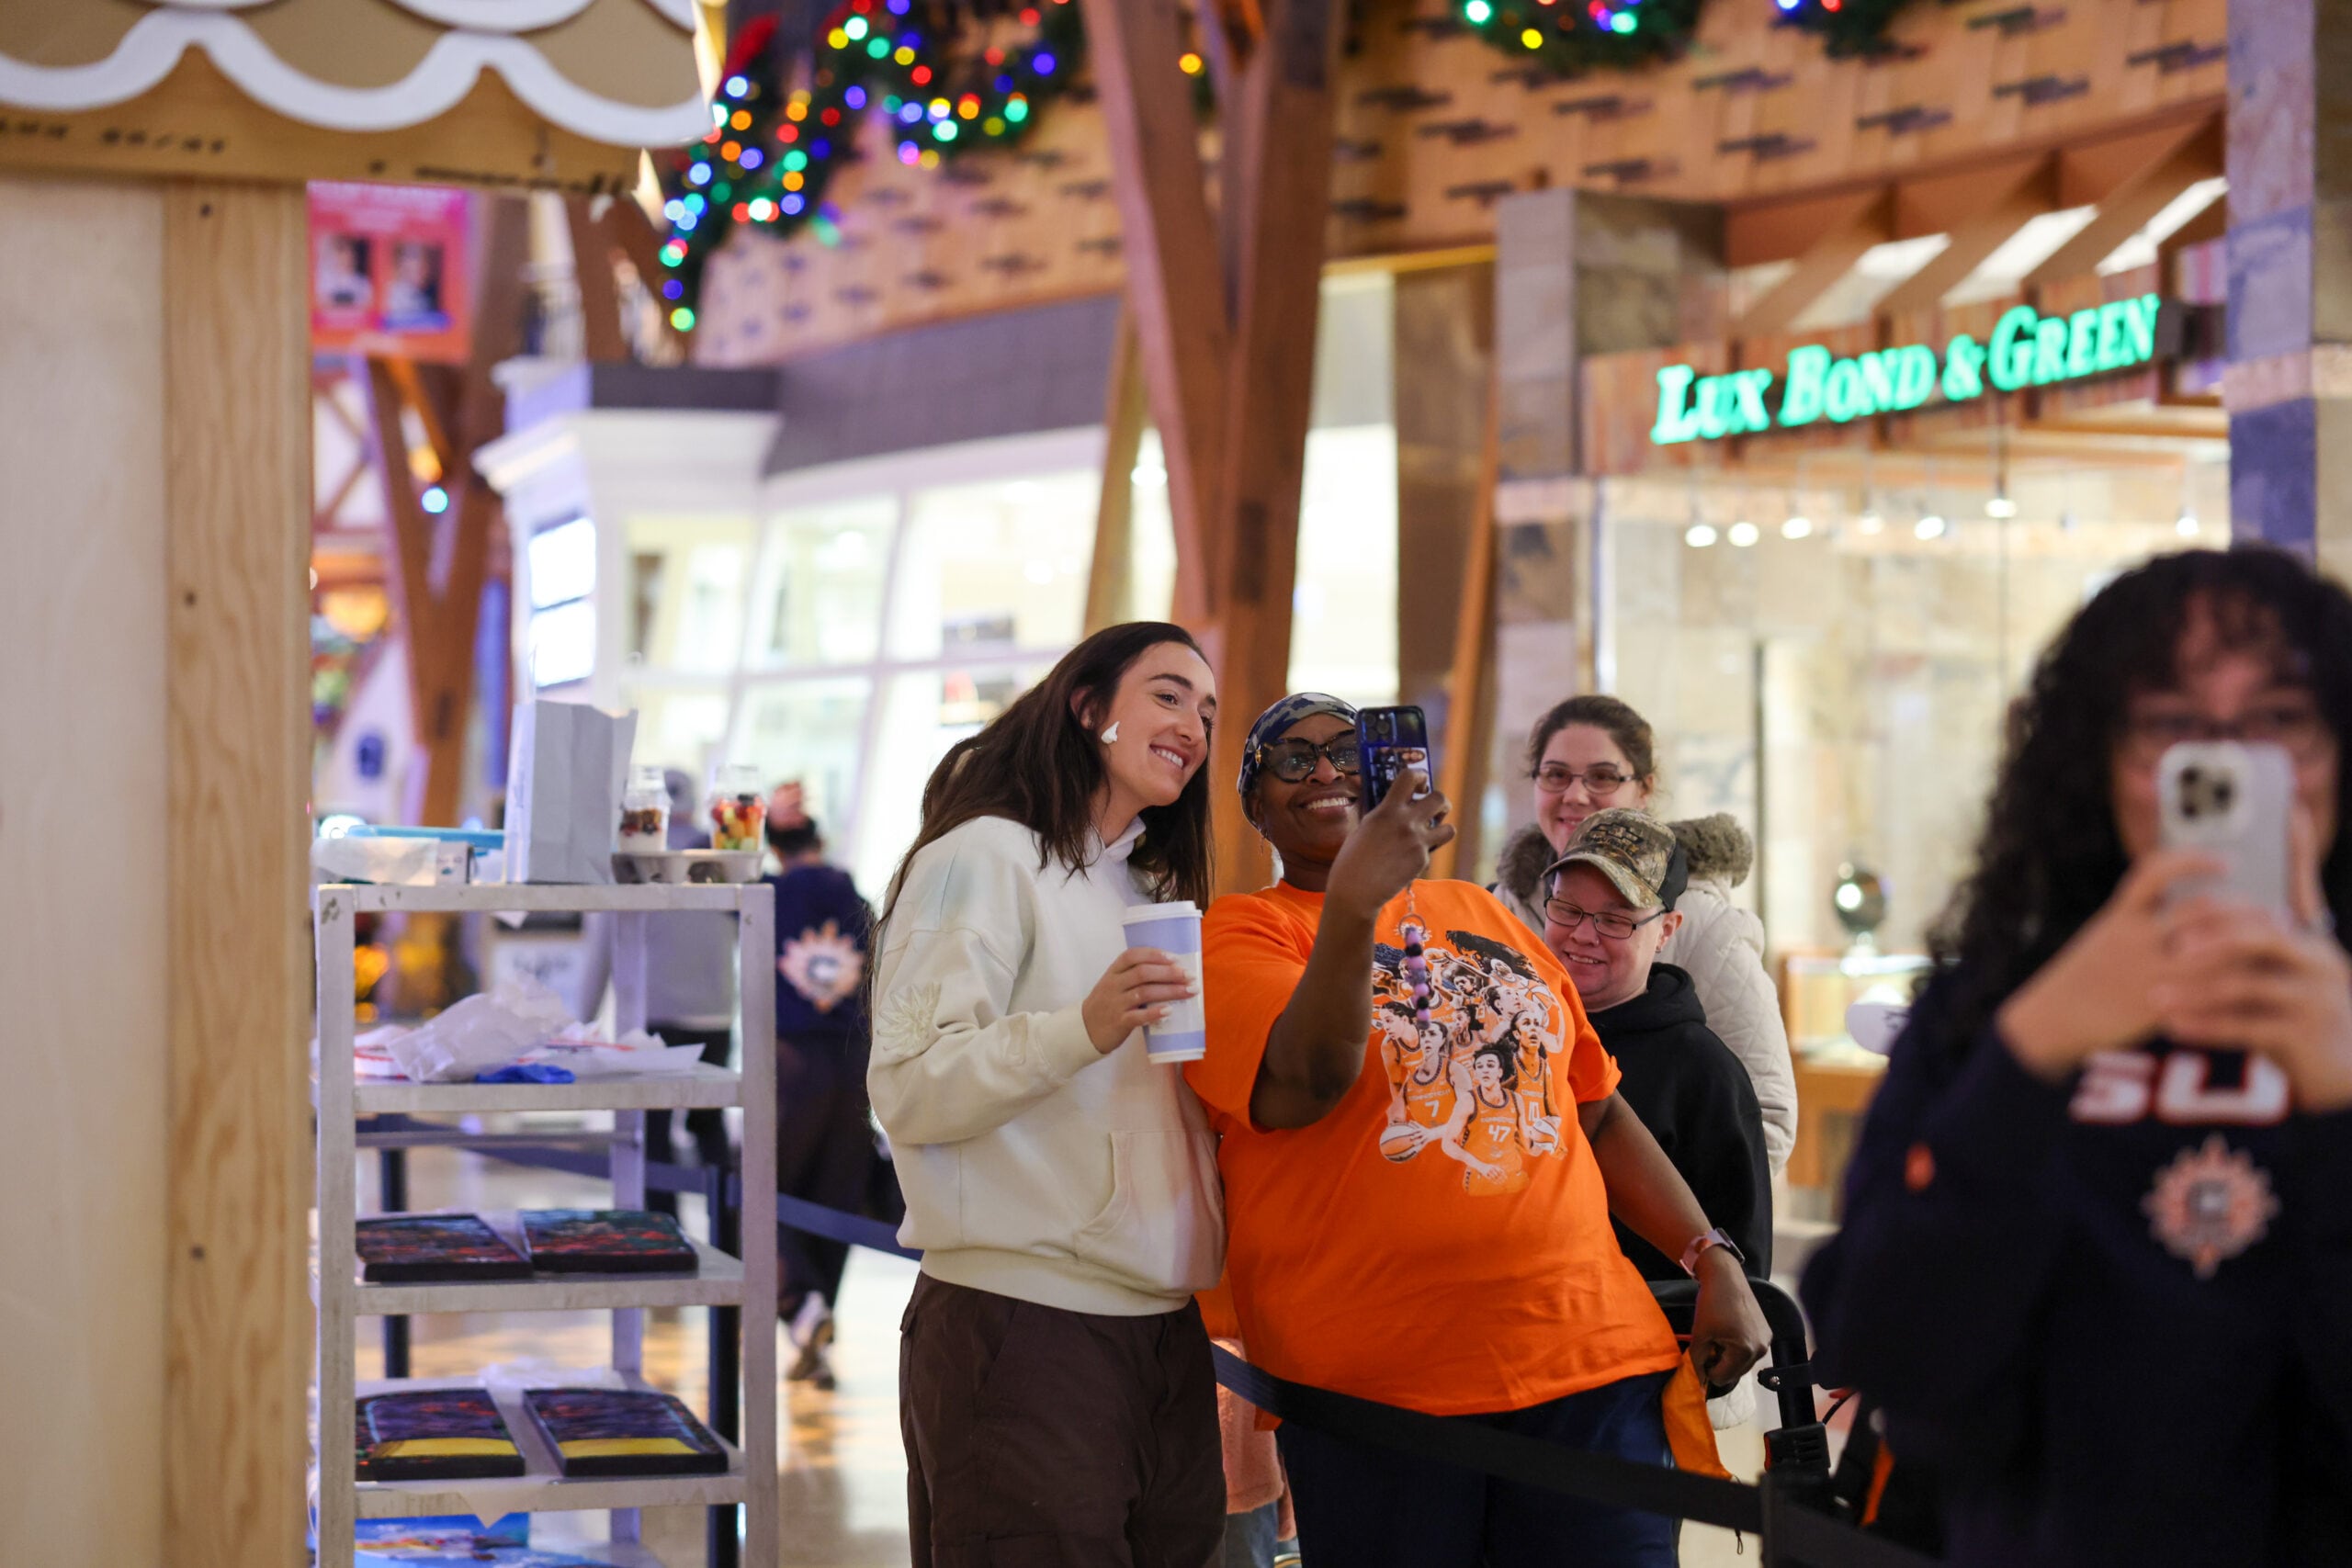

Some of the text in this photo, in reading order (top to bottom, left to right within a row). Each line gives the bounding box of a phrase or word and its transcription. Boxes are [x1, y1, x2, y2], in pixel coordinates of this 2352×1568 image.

[1651, 292, 2161, 446] LUX BOND & GREEN
[1424, 1100, 1440, 1118] 7
[1488, 1124, 1511, 1142] 47
